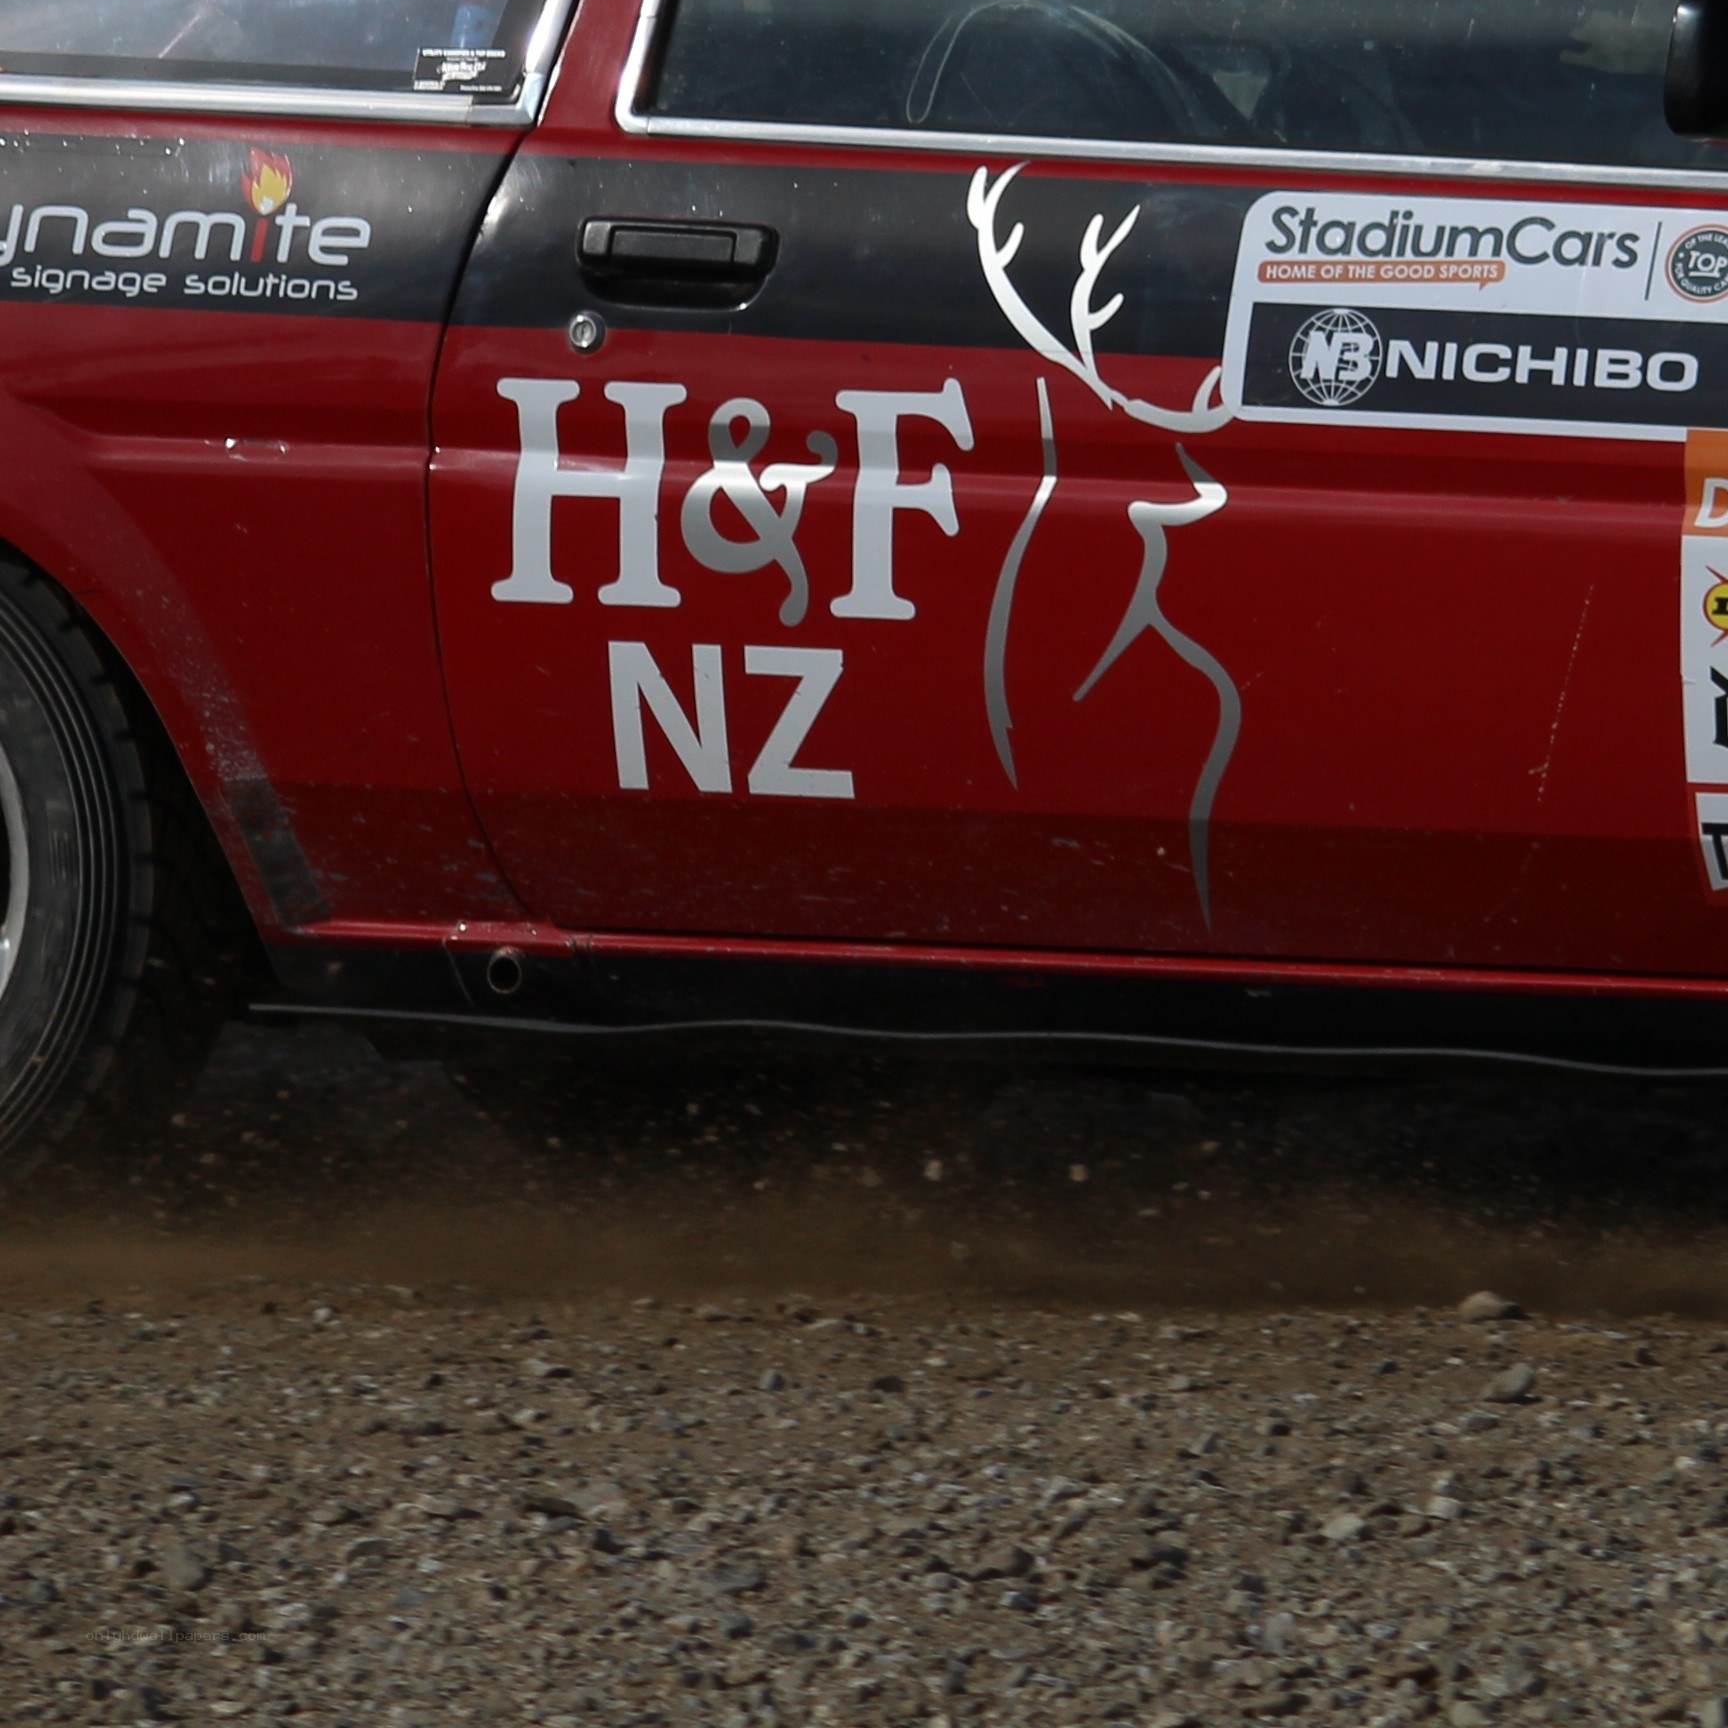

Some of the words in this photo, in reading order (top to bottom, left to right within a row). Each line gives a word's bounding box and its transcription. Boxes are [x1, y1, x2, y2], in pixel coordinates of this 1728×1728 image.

[1264, 205, 1641, 270] StadiumCars
[1697, 233, 1713, 242] THE
[1266, 265, 1315, 279] HOME
[1320, 265, 1344, 279] OF
[1348, 265, 1375, 279] THE
[1379, 265, 1435, 279] GOOD
[1439, 264, 1499, 279] SPORTS
[1688, 250, 1728, 275] TOP
[11, 265, 167, 298] signage
[184, 270, 359, 301] solutions
[1680, 279, 1713, 294] QUALITY
[1386, 338, 1699, 393] NICHIBO
[490, 377, 975, 627] H&F
[608, 640, 856, 801] NZ
